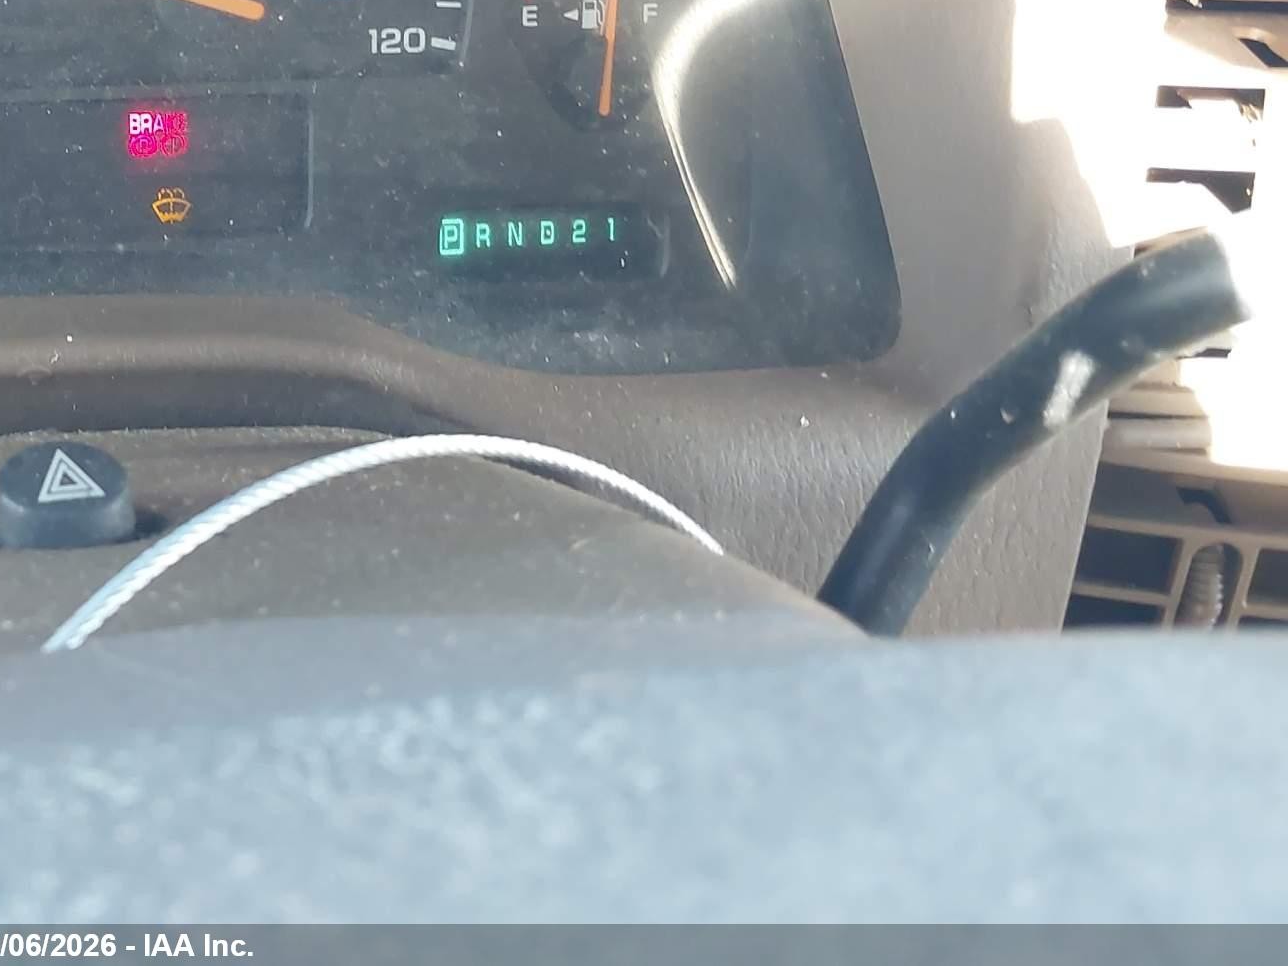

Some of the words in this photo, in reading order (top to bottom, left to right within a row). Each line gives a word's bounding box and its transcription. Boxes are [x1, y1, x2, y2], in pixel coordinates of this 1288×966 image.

[521, 4, 539, 28] E
[643, 2, 659, 24] F
[368, 30, 426, 55] 120
[128, 112, 188, 135] BRAK
[475, 223, 491, 248] R
[508, 221, 523, 246] N
[540, 220, 555, 245] D
[572, 219, 586, 243] 2
[607, 217, 616, 242] 1
